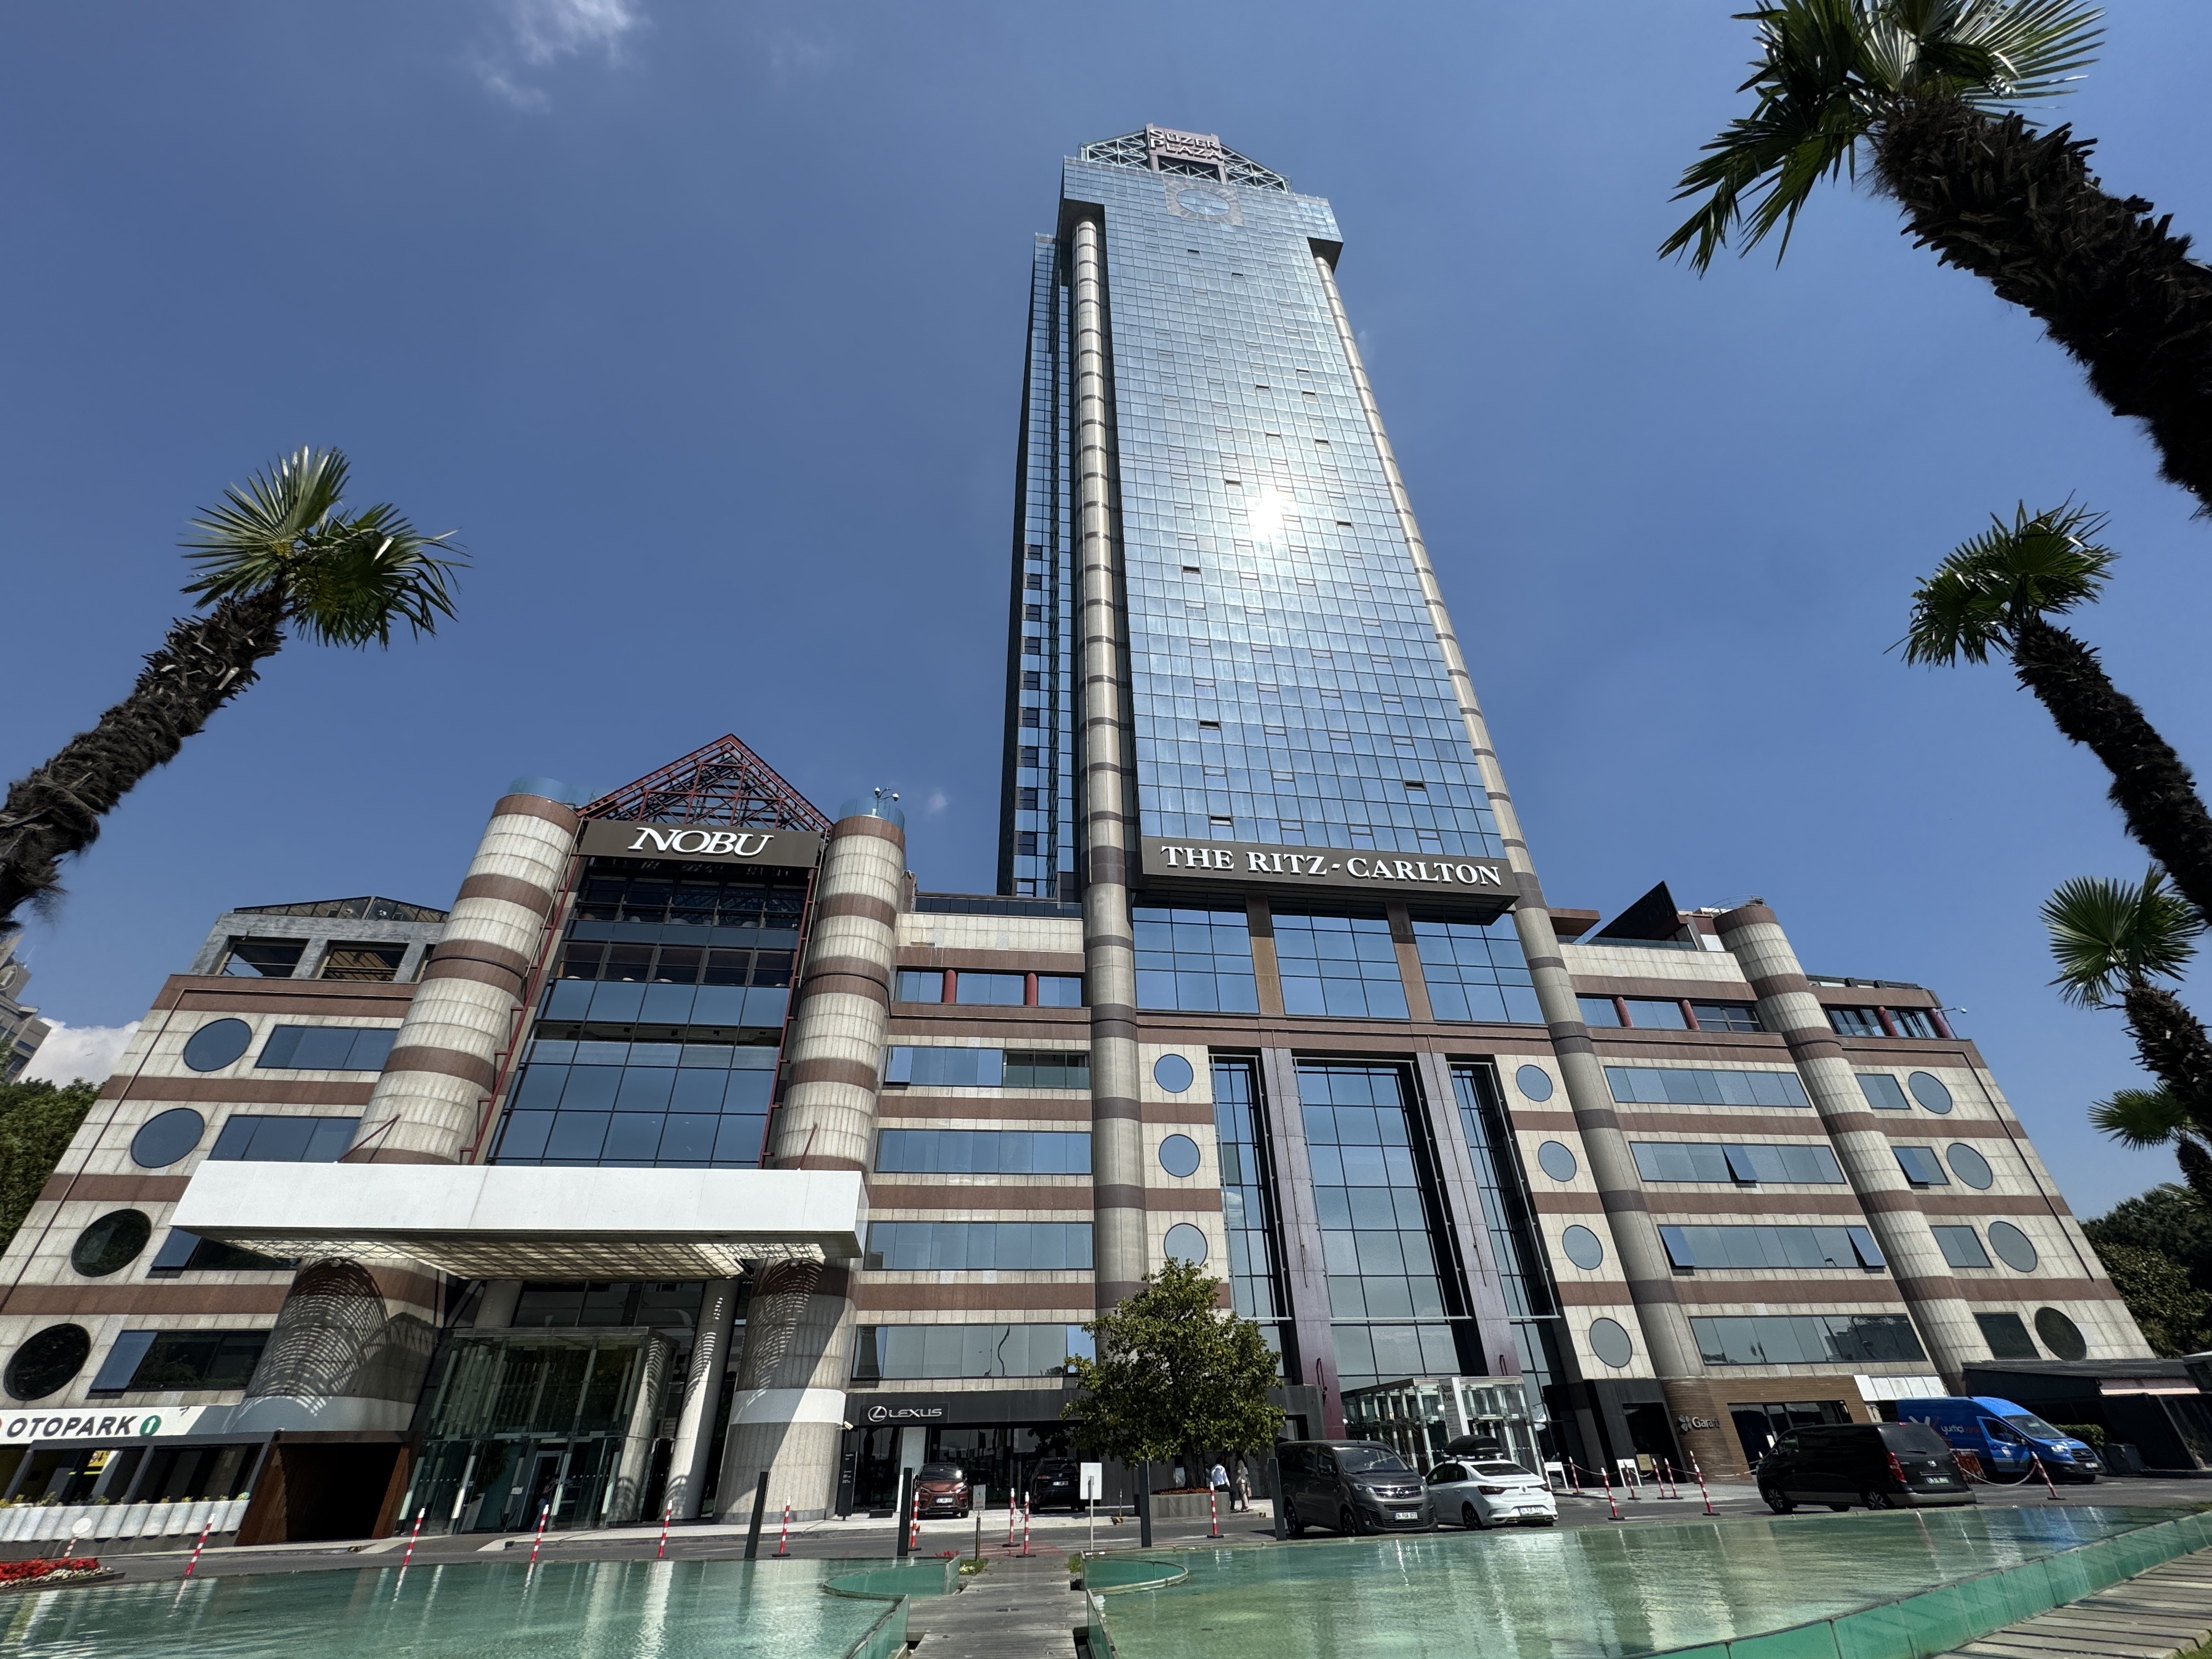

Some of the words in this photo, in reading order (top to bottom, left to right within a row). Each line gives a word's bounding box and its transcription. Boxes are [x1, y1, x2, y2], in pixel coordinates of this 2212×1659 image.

[1149, 129, 1220, 150] SÜZER
[1150, 138, 1223, 160] PLAZA
[627, 827, 775, 856] NOBU
[1161, 845, 1235, 870] THE
[1246, 851, 1502, 886] RITZ-CARLTON
[889, 1408, 943, 1418] LEXUS
[7, 1416, 138, 1438] OTOPARK
